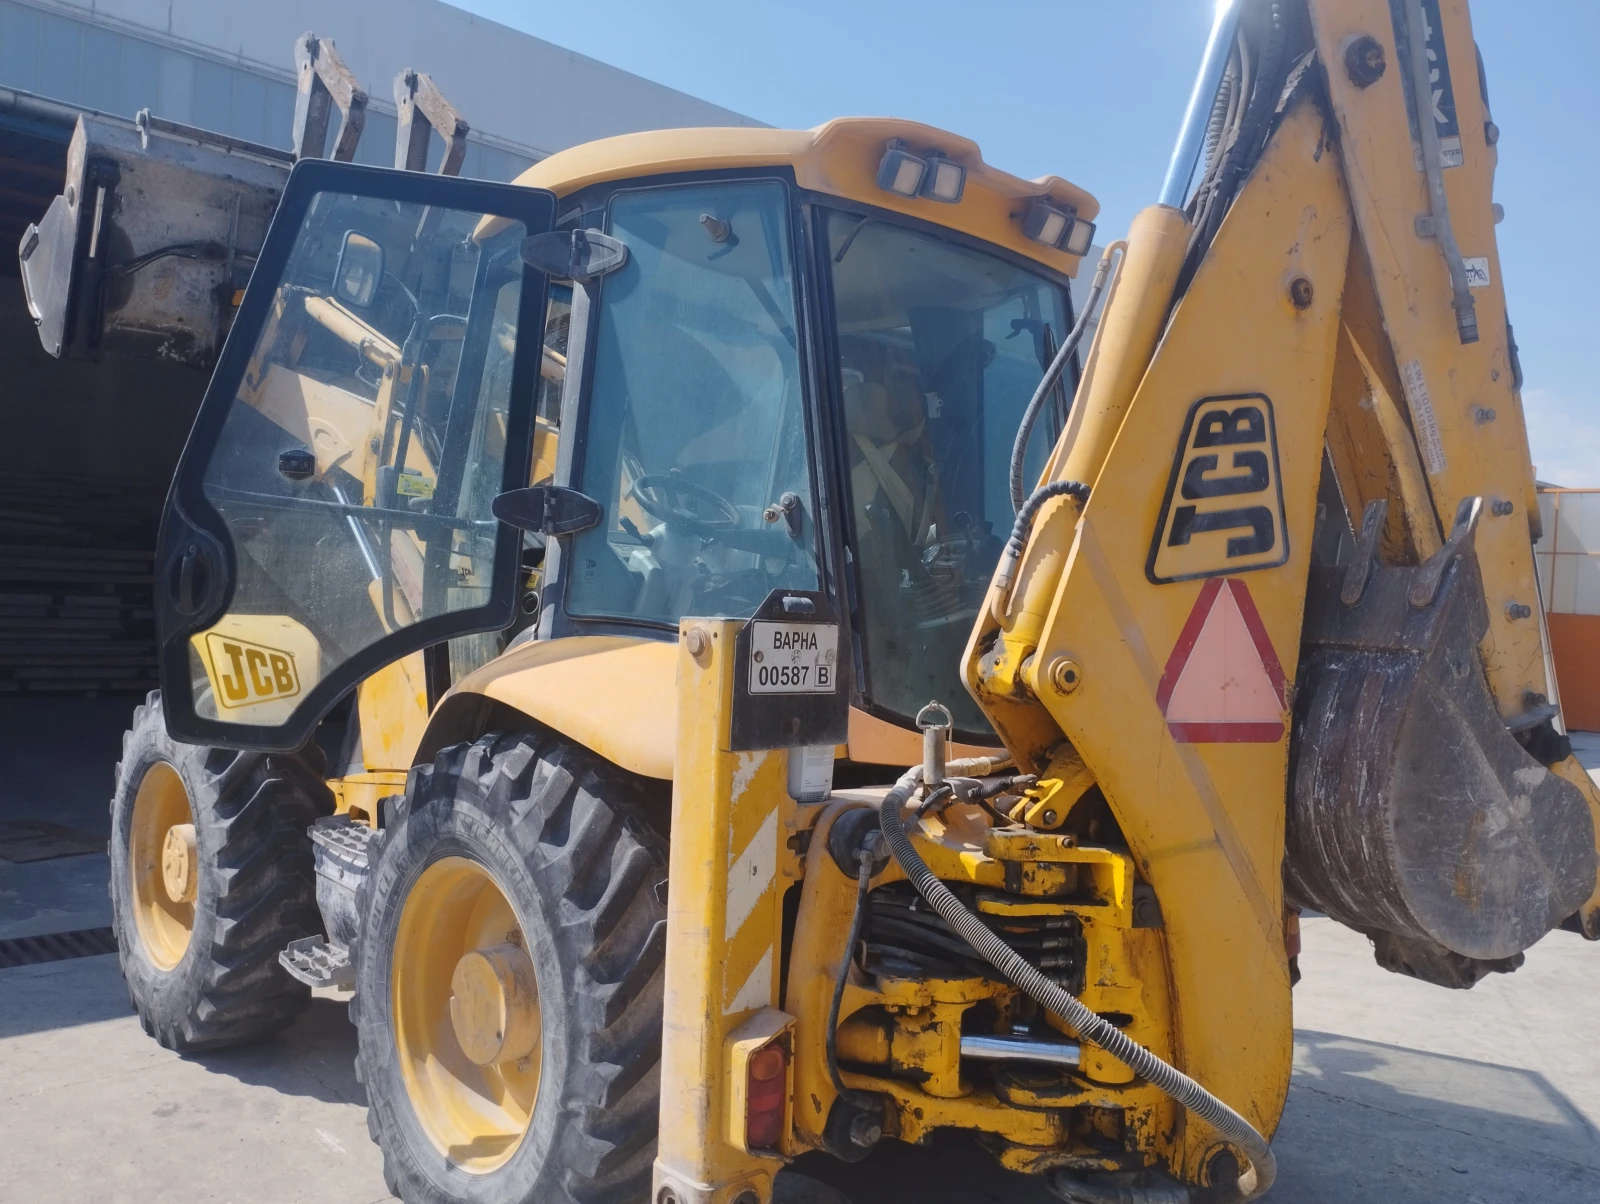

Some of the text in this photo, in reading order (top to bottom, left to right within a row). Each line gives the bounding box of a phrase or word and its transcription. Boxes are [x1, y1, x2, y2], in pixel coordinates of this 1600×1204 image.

[1411, 359, 1425, 390] SWL
[1167, 406, 1275, 558] JCB
[773, 631, 818, 650] ВАРНА
[222, 642, 294, 700] JCB
[758, 665, 809, 686] 00587
